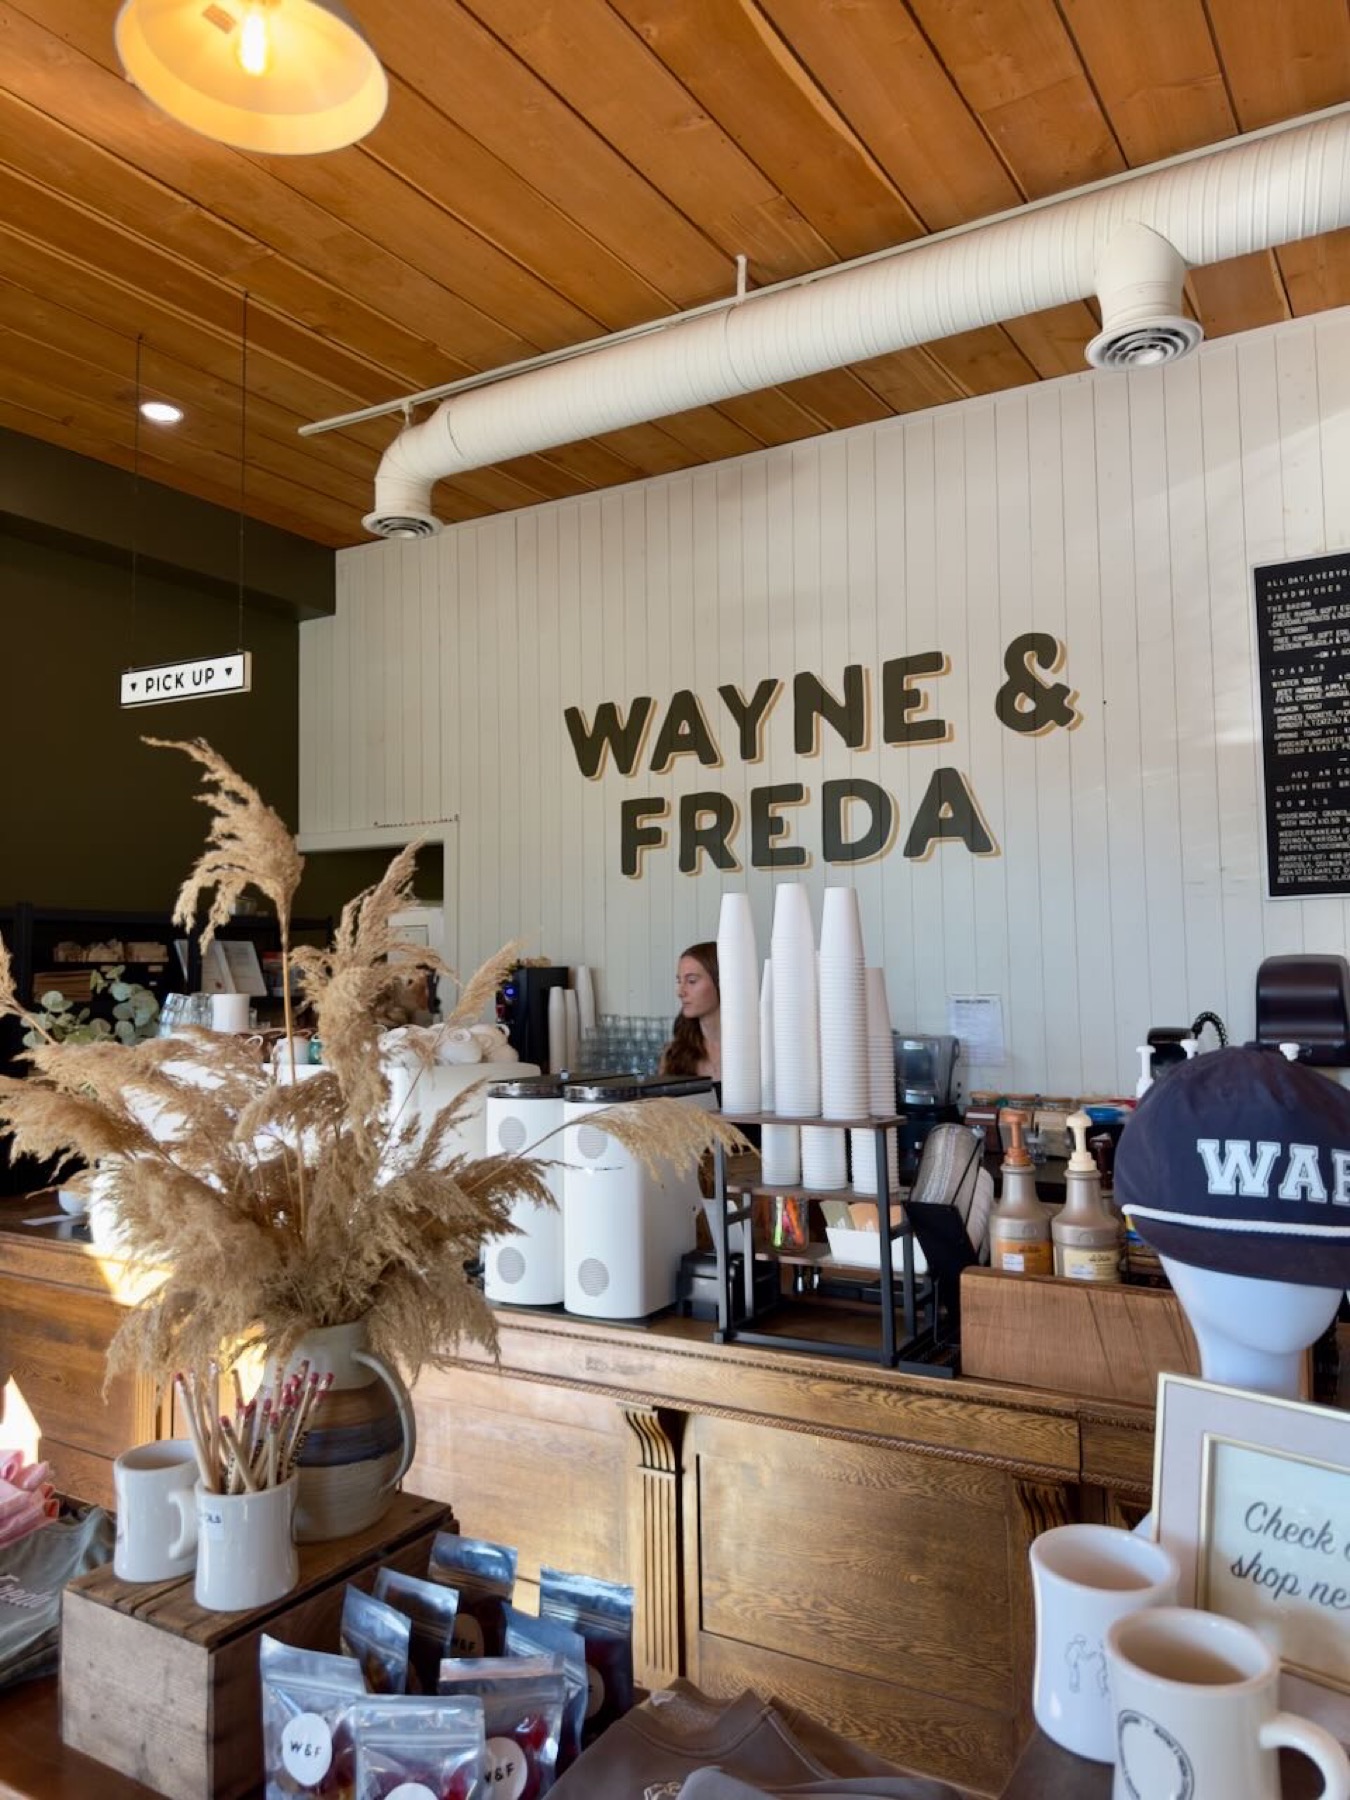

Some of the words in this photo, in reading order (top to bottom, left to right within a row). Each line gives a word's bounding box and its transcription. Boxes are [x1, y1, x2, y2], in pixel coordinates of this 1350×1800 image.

[145, 672, 185, 693] PICK
[192, 667, 215, 686] UP
[563, 650, 953, 780] WAYNE
[994, 632, 1084, 736] &
[620, 767, 1001, 879] FREDA
[1245, 1501, 1336, 1555] Check
[1231, 1551, 1301, 1601] shop
